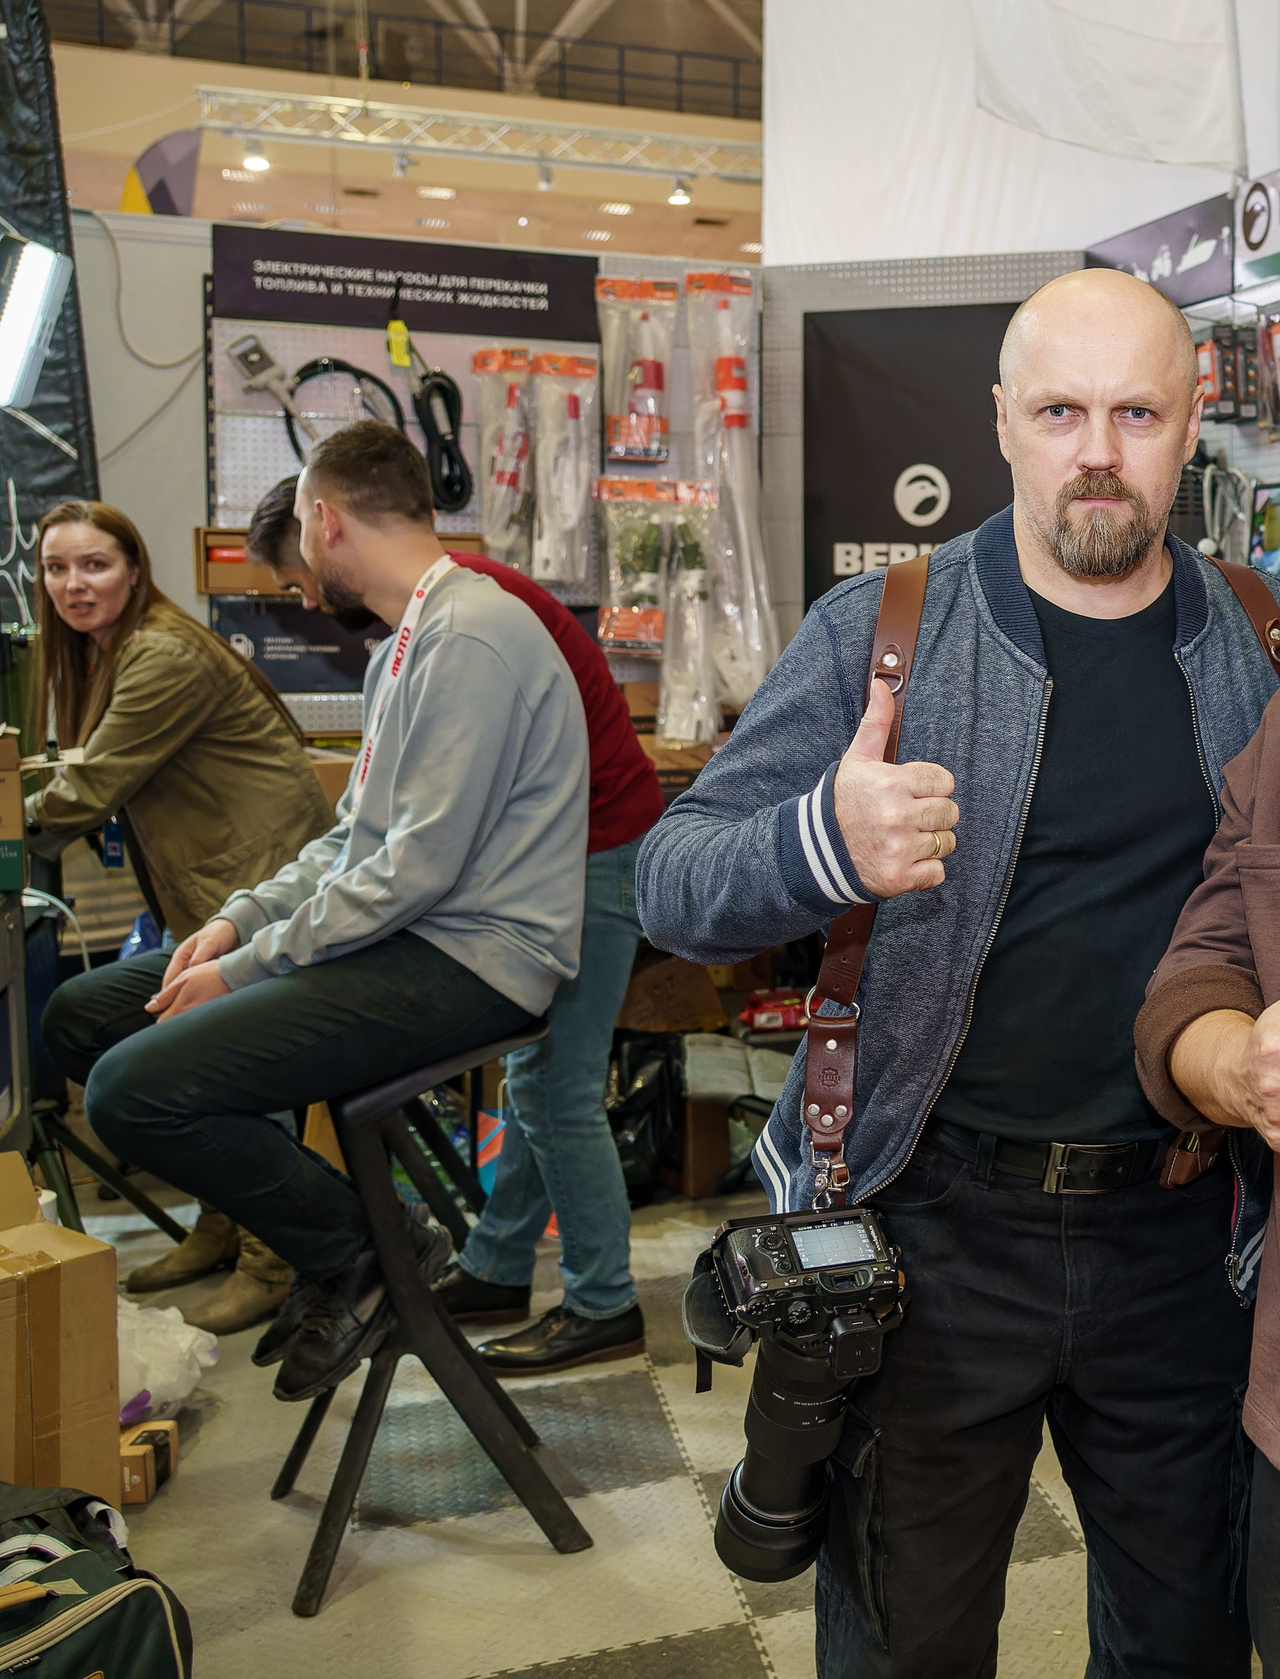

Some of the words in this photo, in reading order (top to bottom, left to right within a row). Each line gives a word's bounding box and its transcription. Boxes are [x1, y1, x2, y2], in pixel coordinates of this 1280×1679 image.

[253, 259, 375, 281] ЭЛЕКТРИЧЕСКИЕ
[438, 274, 468, 290] ДЛЯ
[468, 276, 549, 296] ПЕРЕКАЧКИ
[253, 275, 328, 295] ТОПЛИВА
[331, 282, 343, 296] И
[456, 290, 549, 312] ЖИДКОСТЕЙ
[391, 627, 411, 678] MOTO
